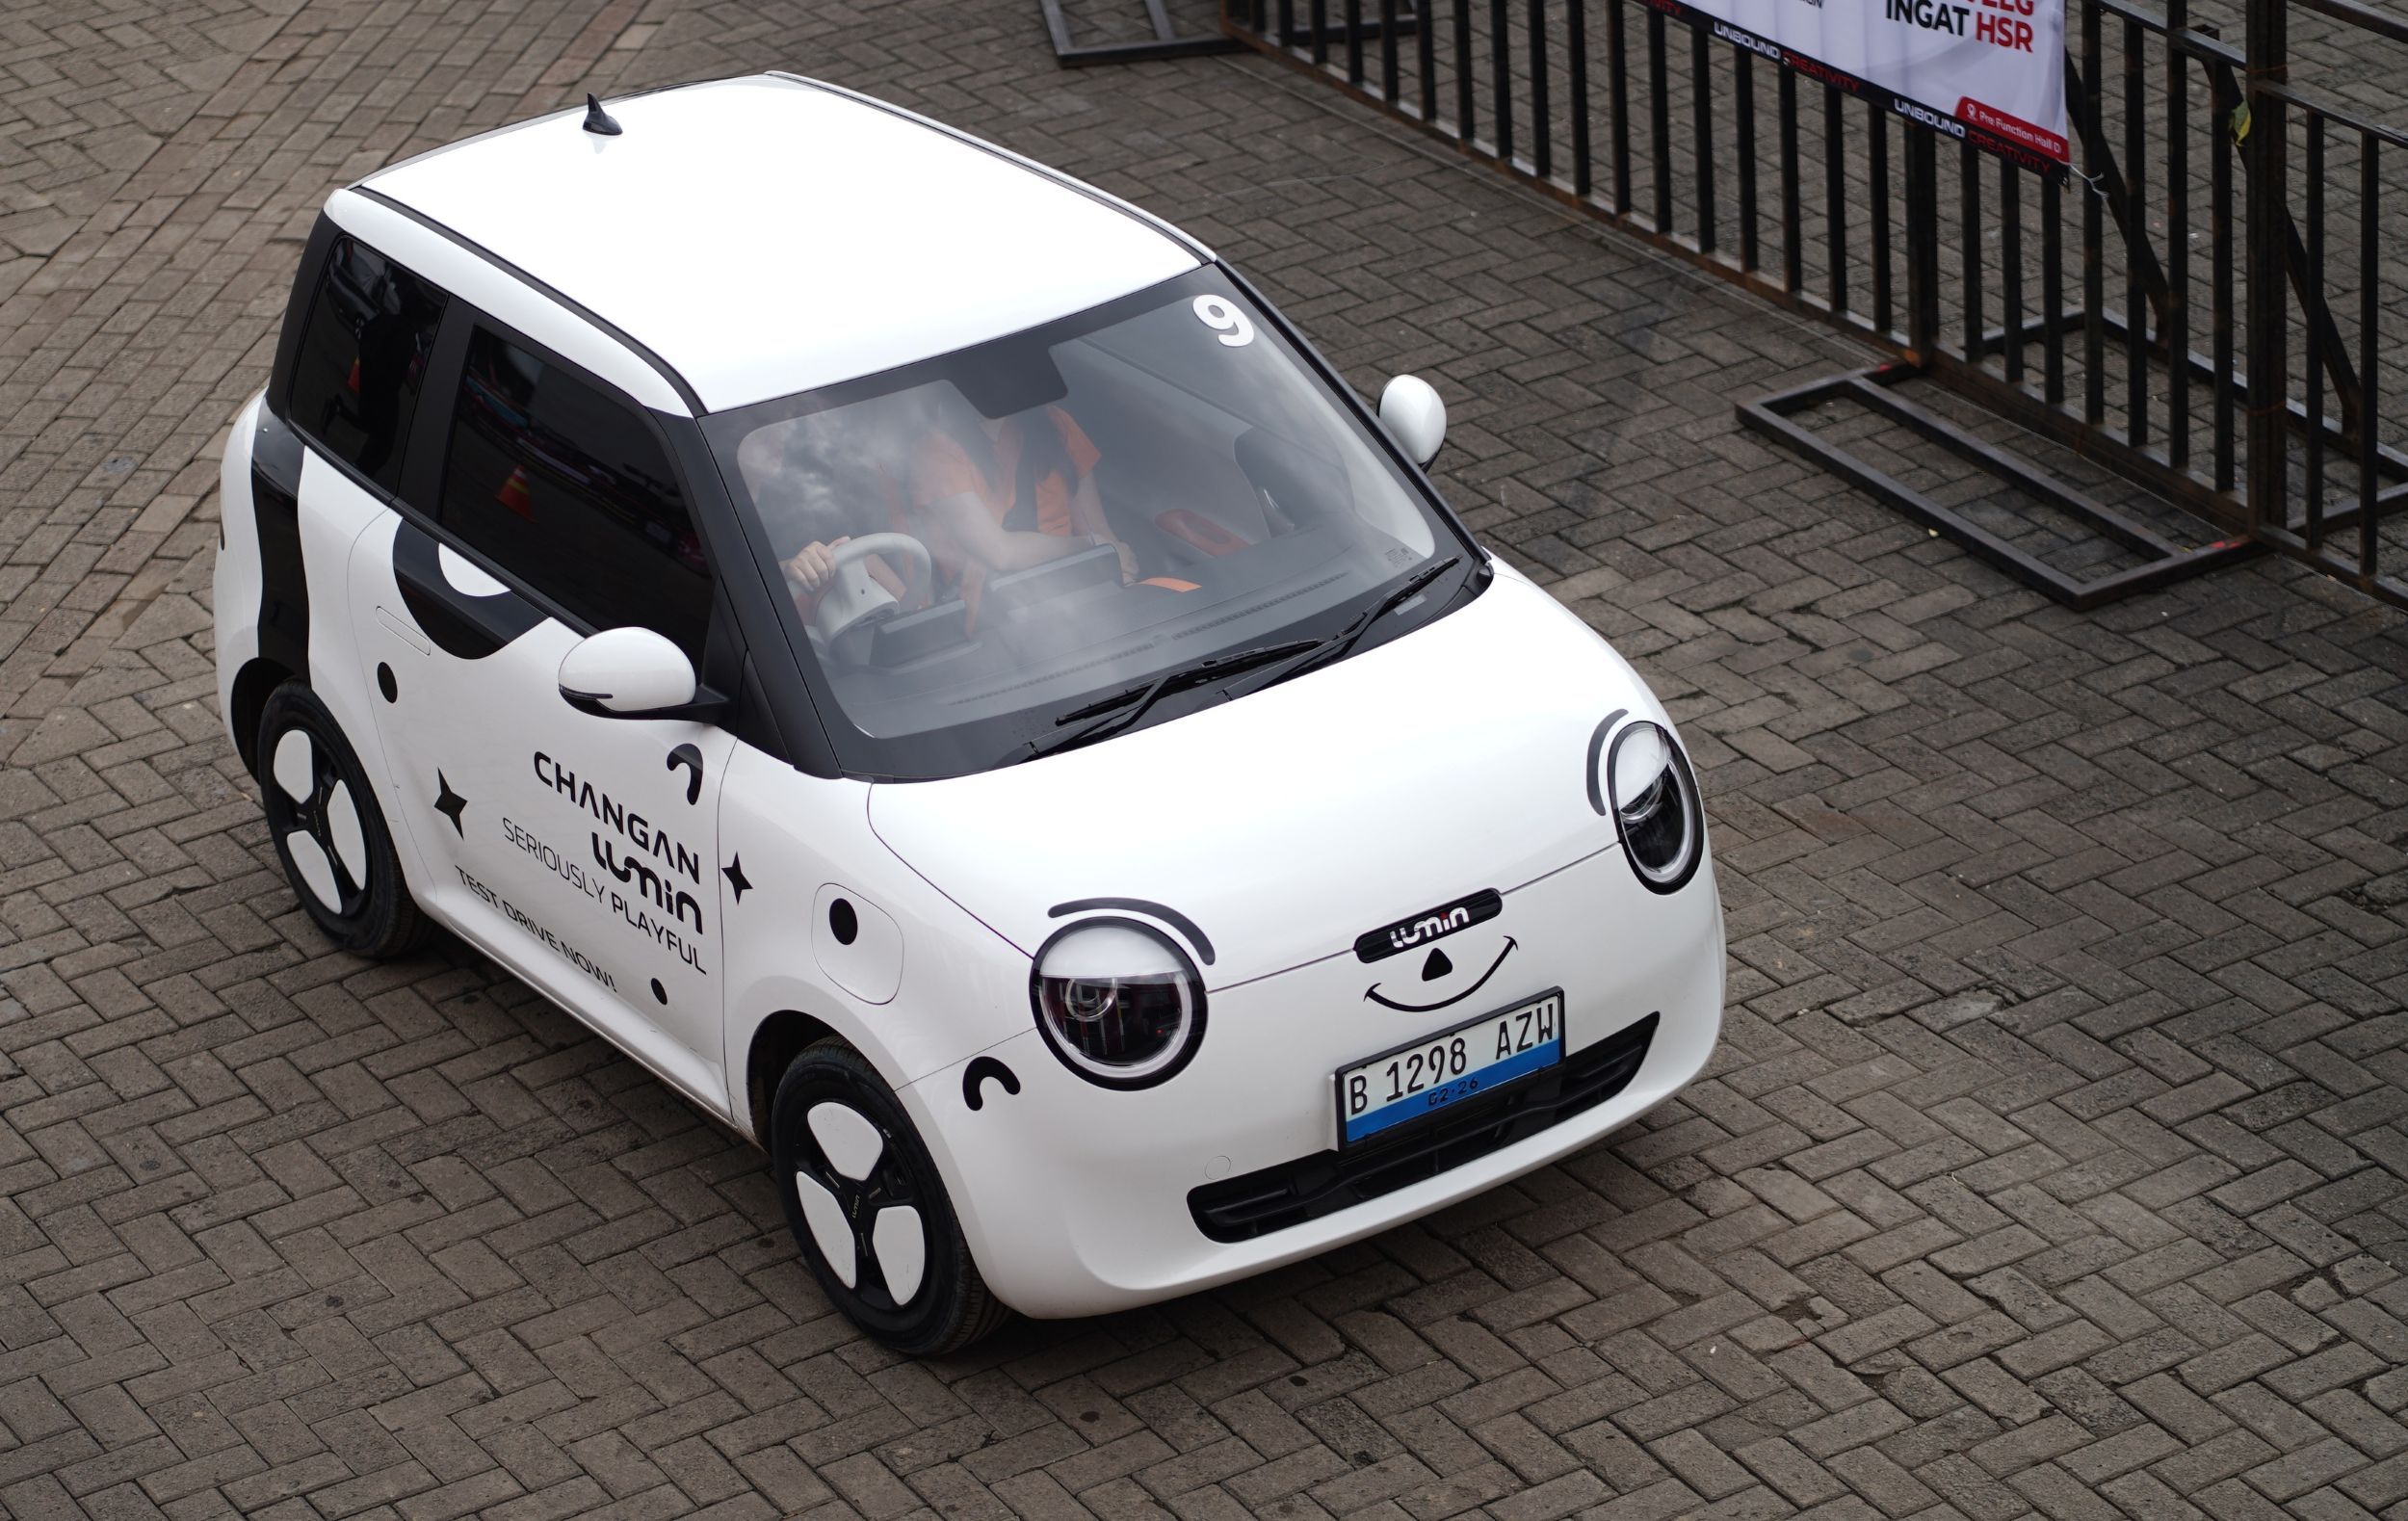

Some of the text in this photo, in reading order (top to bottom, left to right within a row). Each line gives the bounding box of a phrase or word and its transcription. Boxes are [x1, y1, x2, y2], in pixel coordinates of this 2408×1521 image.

[1714, 21, 1780, 60] UNBOUND
[1886, 0, 1970, 37] INGAT
[1976, 12, 2033, 53] HSR
[1894, 98, 2051, 172] UNBOUND CREATIVITY
[1979, 111, 1995, 125] Pre
[1996, 118, 2034, 143] Function
[1192, 294, 1255, 348] 9
[534, 750, 700, 885] CHANGAN
[454, 864, 617, 993] TEST DRIVE NOW!
[502, 817, 707, 976] SERIOUSLY PLAYFUL
[1349, 1003, 1555, 1115] B 1298 AZW
